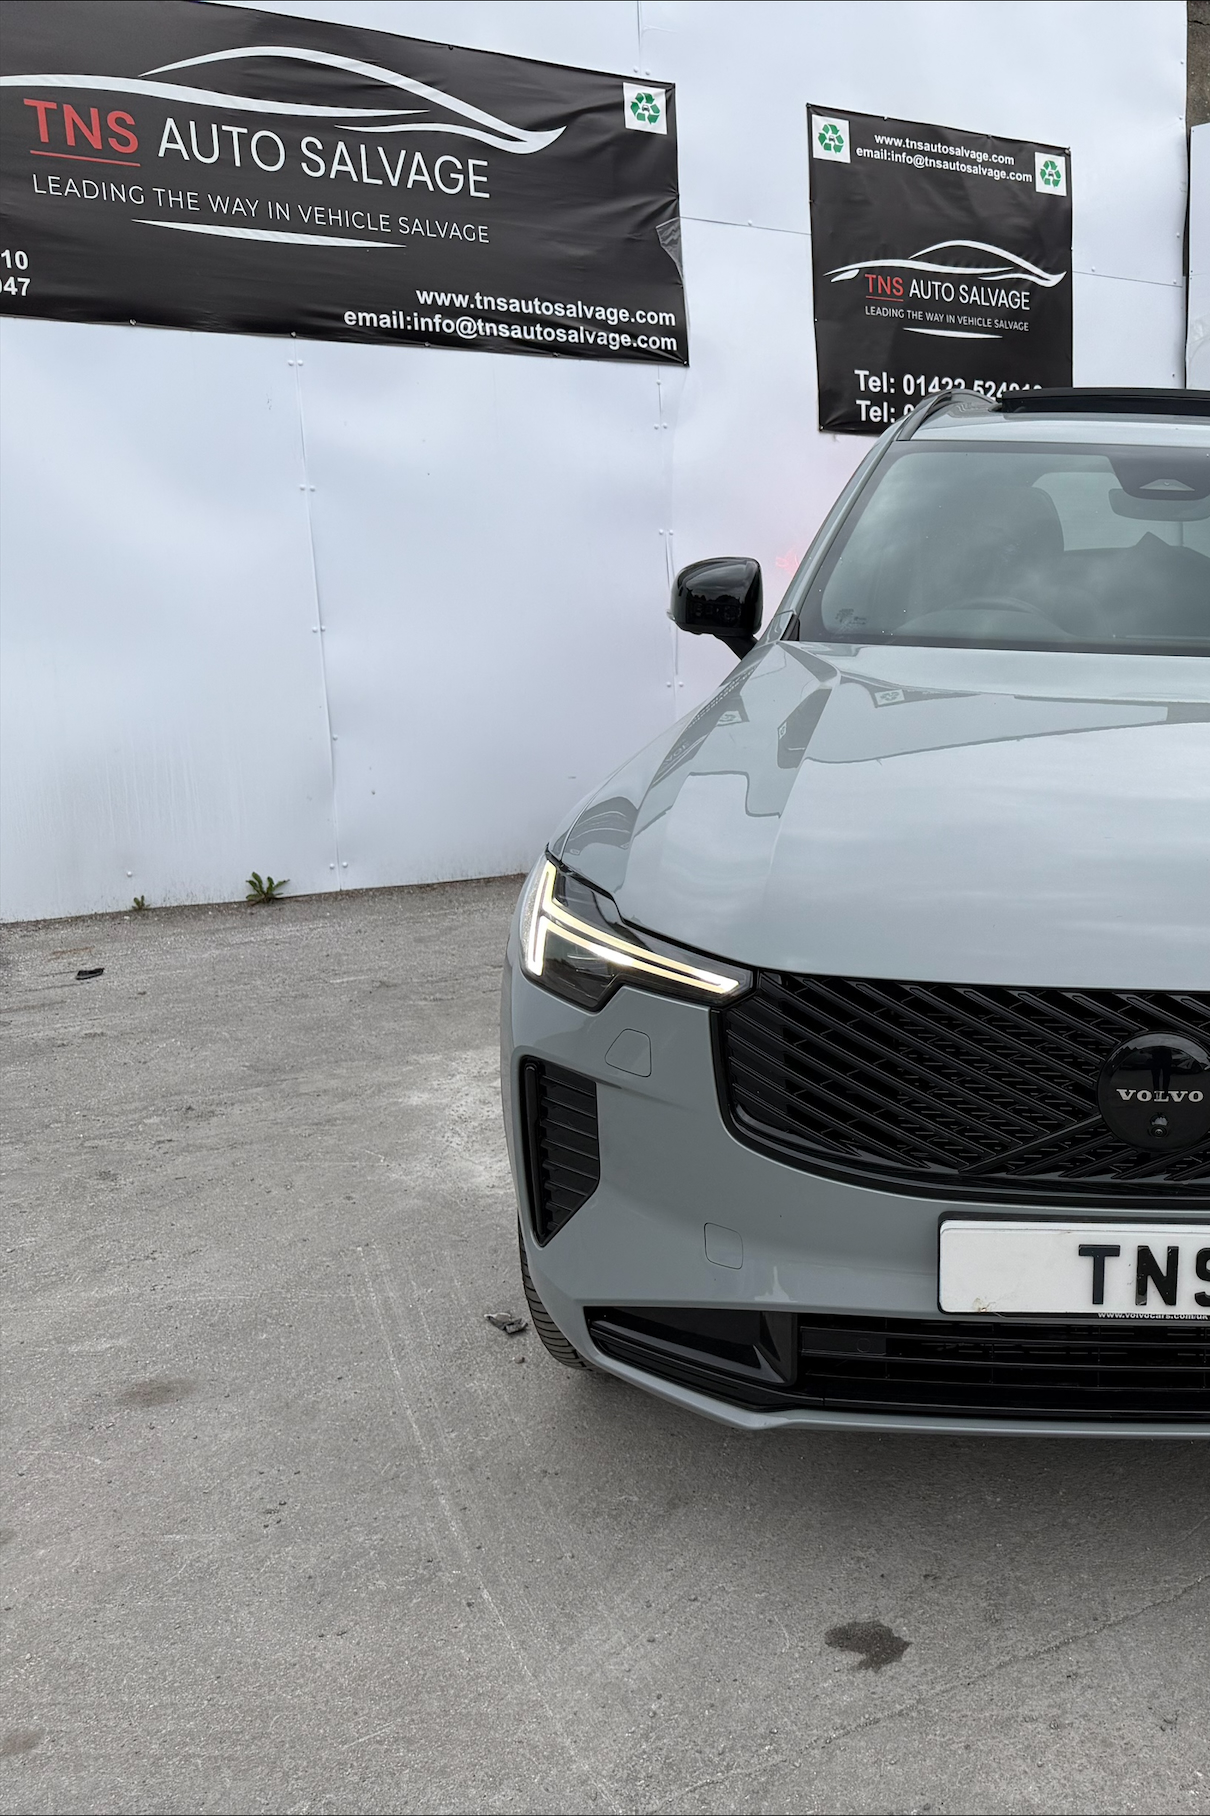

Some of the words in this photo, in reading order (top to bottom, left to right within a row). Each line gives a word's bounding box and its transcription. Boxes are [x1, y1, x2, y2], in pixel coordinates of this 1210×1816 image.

[23, 98, 139, 154] TNS
[158, 117, 286, 172] AUTO
[300, 136, 490, 198] SALVAGE
[856, 146, 1033, 182] email:info@tnsautosalvage.com
[874, 134, 1015, 165] www.tnsautosalvage.com
[33, 173, 145, 205] LEADING
[152, 187, 200, 211] THE
[207, 193, 259, 217] WAY
[268, 201, 290, 221] IN
[298, 204, 391, 232] VEHICLE
[398, 216, 490, 243] SALVAGE
[0, 276, 31, 297] 47
[864, 273, 904, 296] TNS
[909, 278, 955, 302] AUTO
[959, 284, 1031, 310] SALVAGE
[416, 289, 676, 327] www.tnsautosalvage.com
[865, 306, 904, 319] LEADING
[907, 309, 923, 321] THE
[925, 312, 944, 323] WAY
[946, 314, 955, 324] IN
[957, 315, 992, 328] VEHICLE
[994, 319, 1029, 332] SALVAGE
[343, 310, 678, 351] email:info@tnsautosalvage.com
[854, 369, 895, 394] Tel:
[973, 380, 1042, 400] 524
[855, 399, 896, 423] Tel:
[1116, 1088, 1204, 1103] VOLVO
